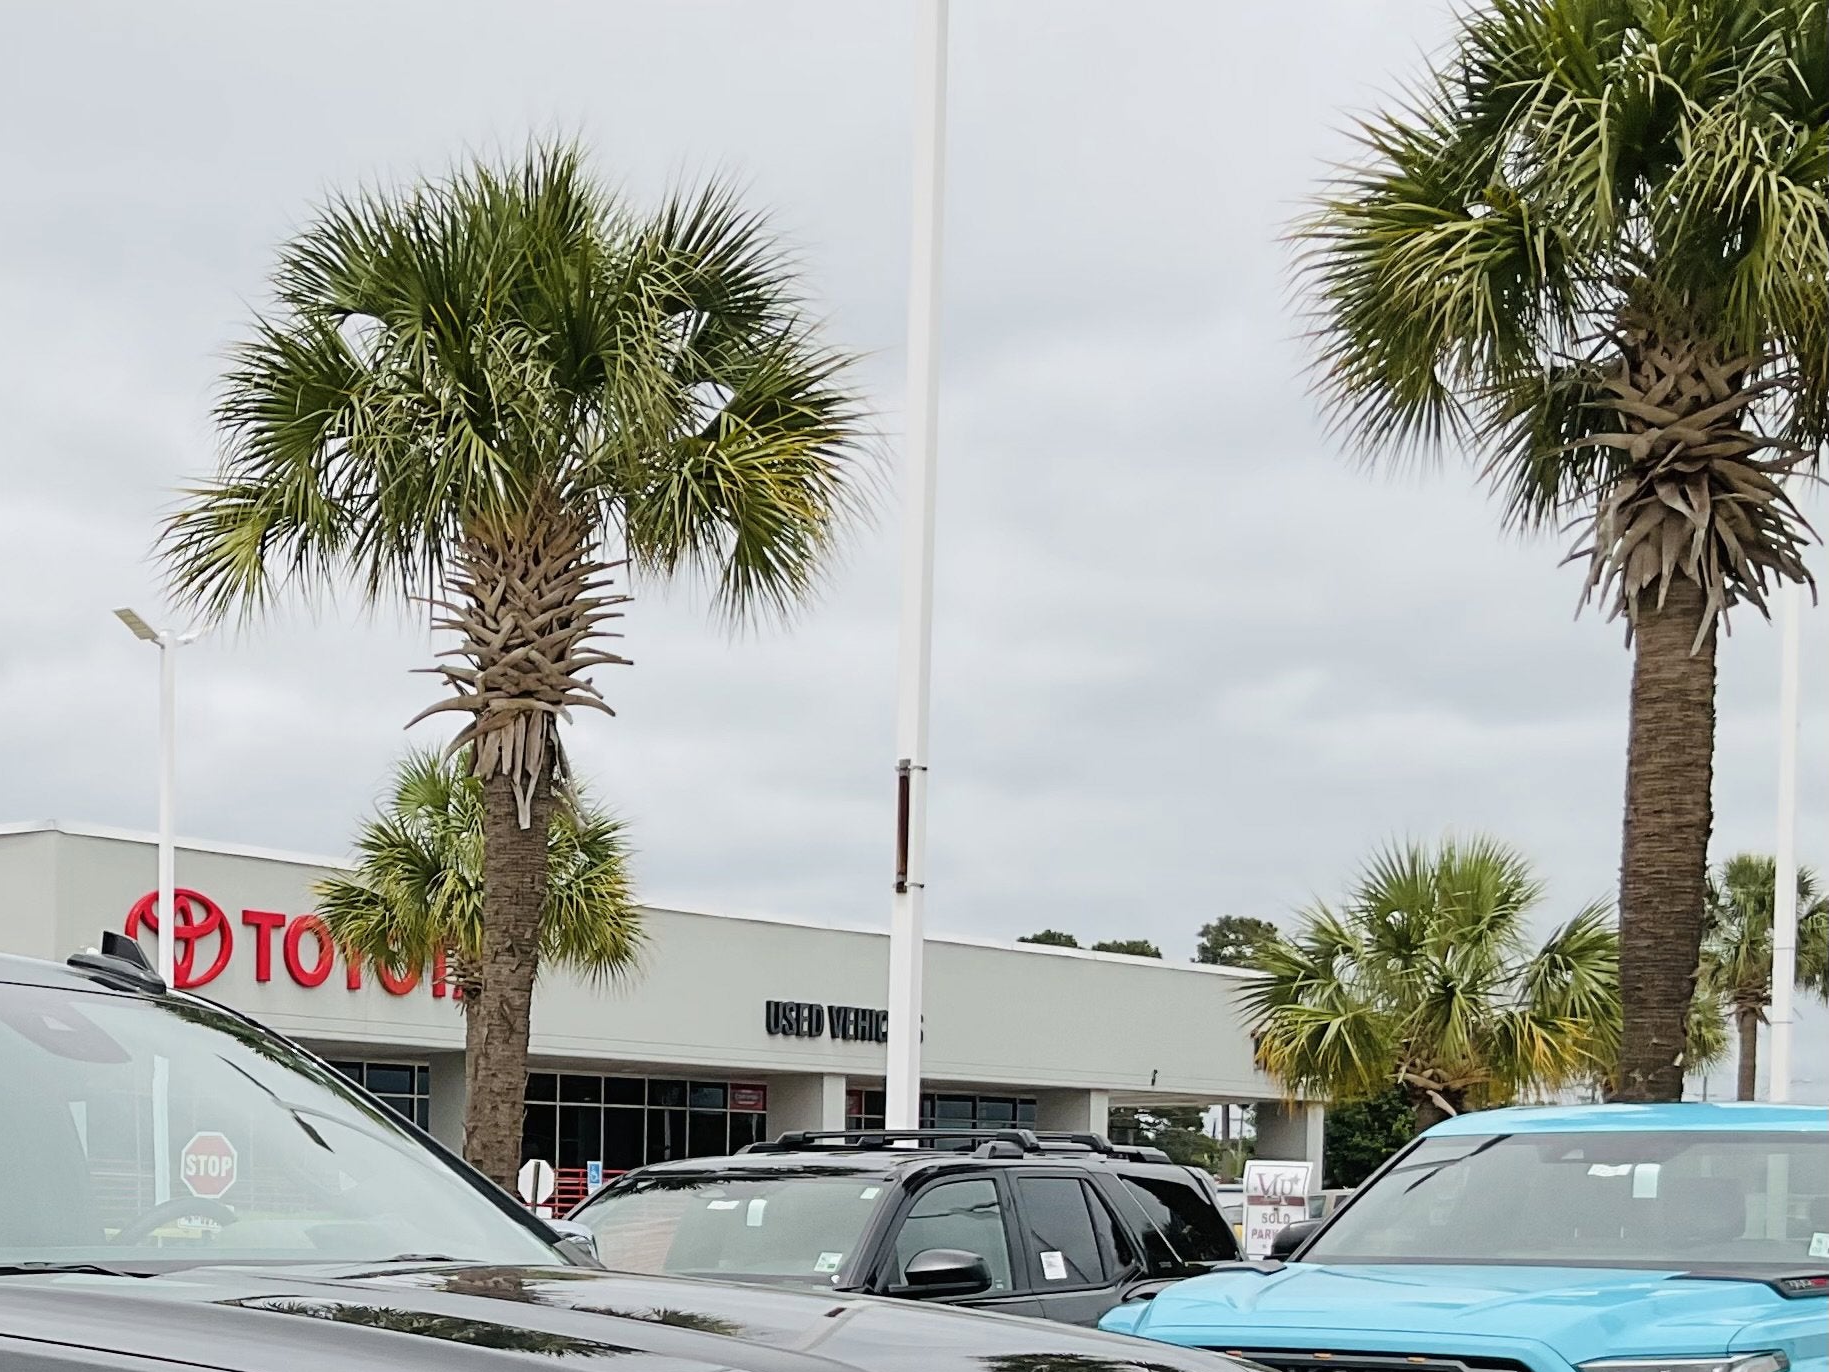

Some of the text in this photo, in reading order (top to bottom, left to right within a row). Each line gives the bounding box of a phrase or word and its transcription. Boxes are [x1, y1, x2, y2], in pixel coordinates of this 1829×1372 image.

[766, 1000, 924, 1044] USED VEHIC
[185, 1154, 232, 1177] STOP
[1261, 1212, 1291, 1225] SOLD
